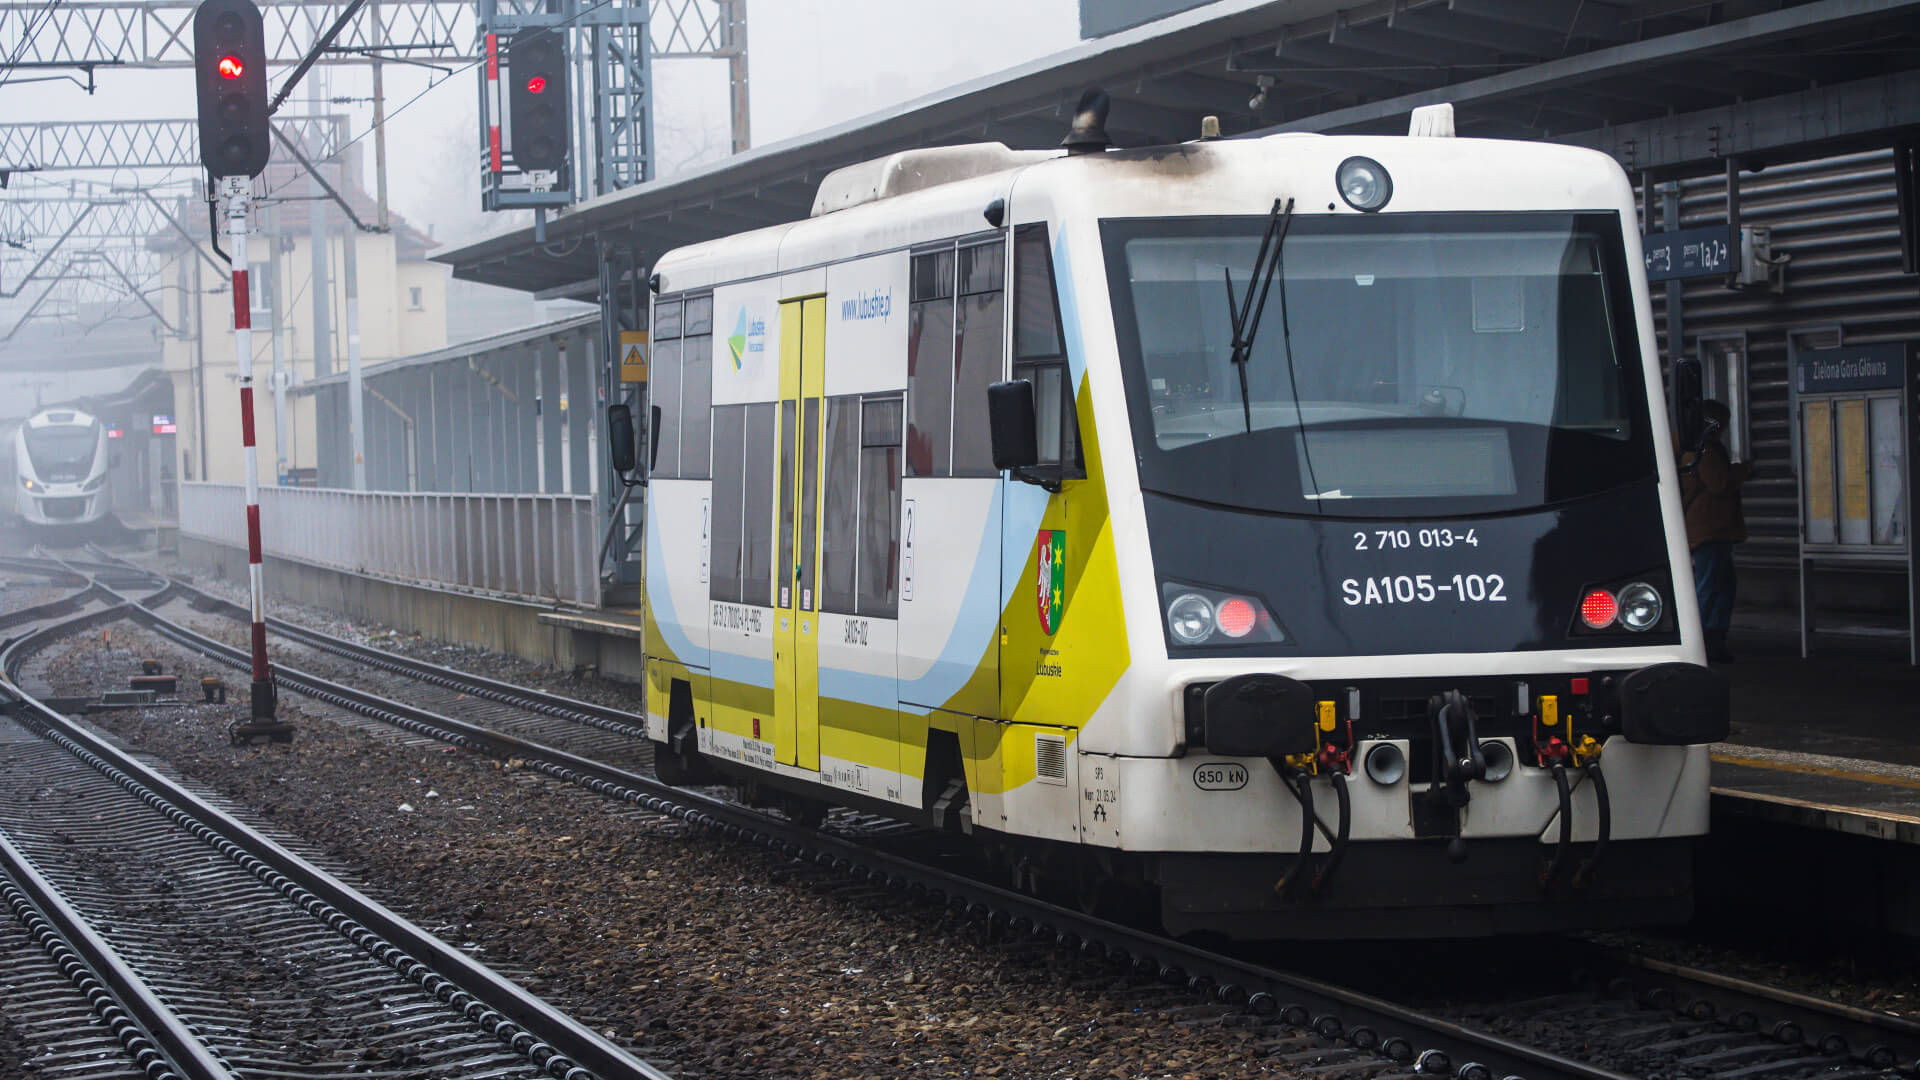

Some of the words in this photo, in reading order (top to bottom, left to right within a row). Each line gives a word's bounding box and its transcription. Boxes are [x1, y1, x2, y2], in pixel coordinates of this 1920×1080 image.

[1665, 246, 1671, 272] 3
[1700, 240, 1720, 271] 1a,2
[841, 285, 892, 325] www.lubuskie.pl
[1813, 360, 1840, 380] Zielona
[1840, 359, 1859, 378] Góra
[1859, 357, 1888, 377] Główna
[906, 506, 912, 549] 2
[1353, 532, 1369, 551] 2
[1375, 529, 1412, 550] 710
[1418, 528, 1479, 547] 013-4
[1341, 573, 1507, 606] SA105-102
[1036, 659, 1062, 678] Lubuskie
[1198, 770, 1223, 783] 850
[1228, 770, 1244, 783] kN
